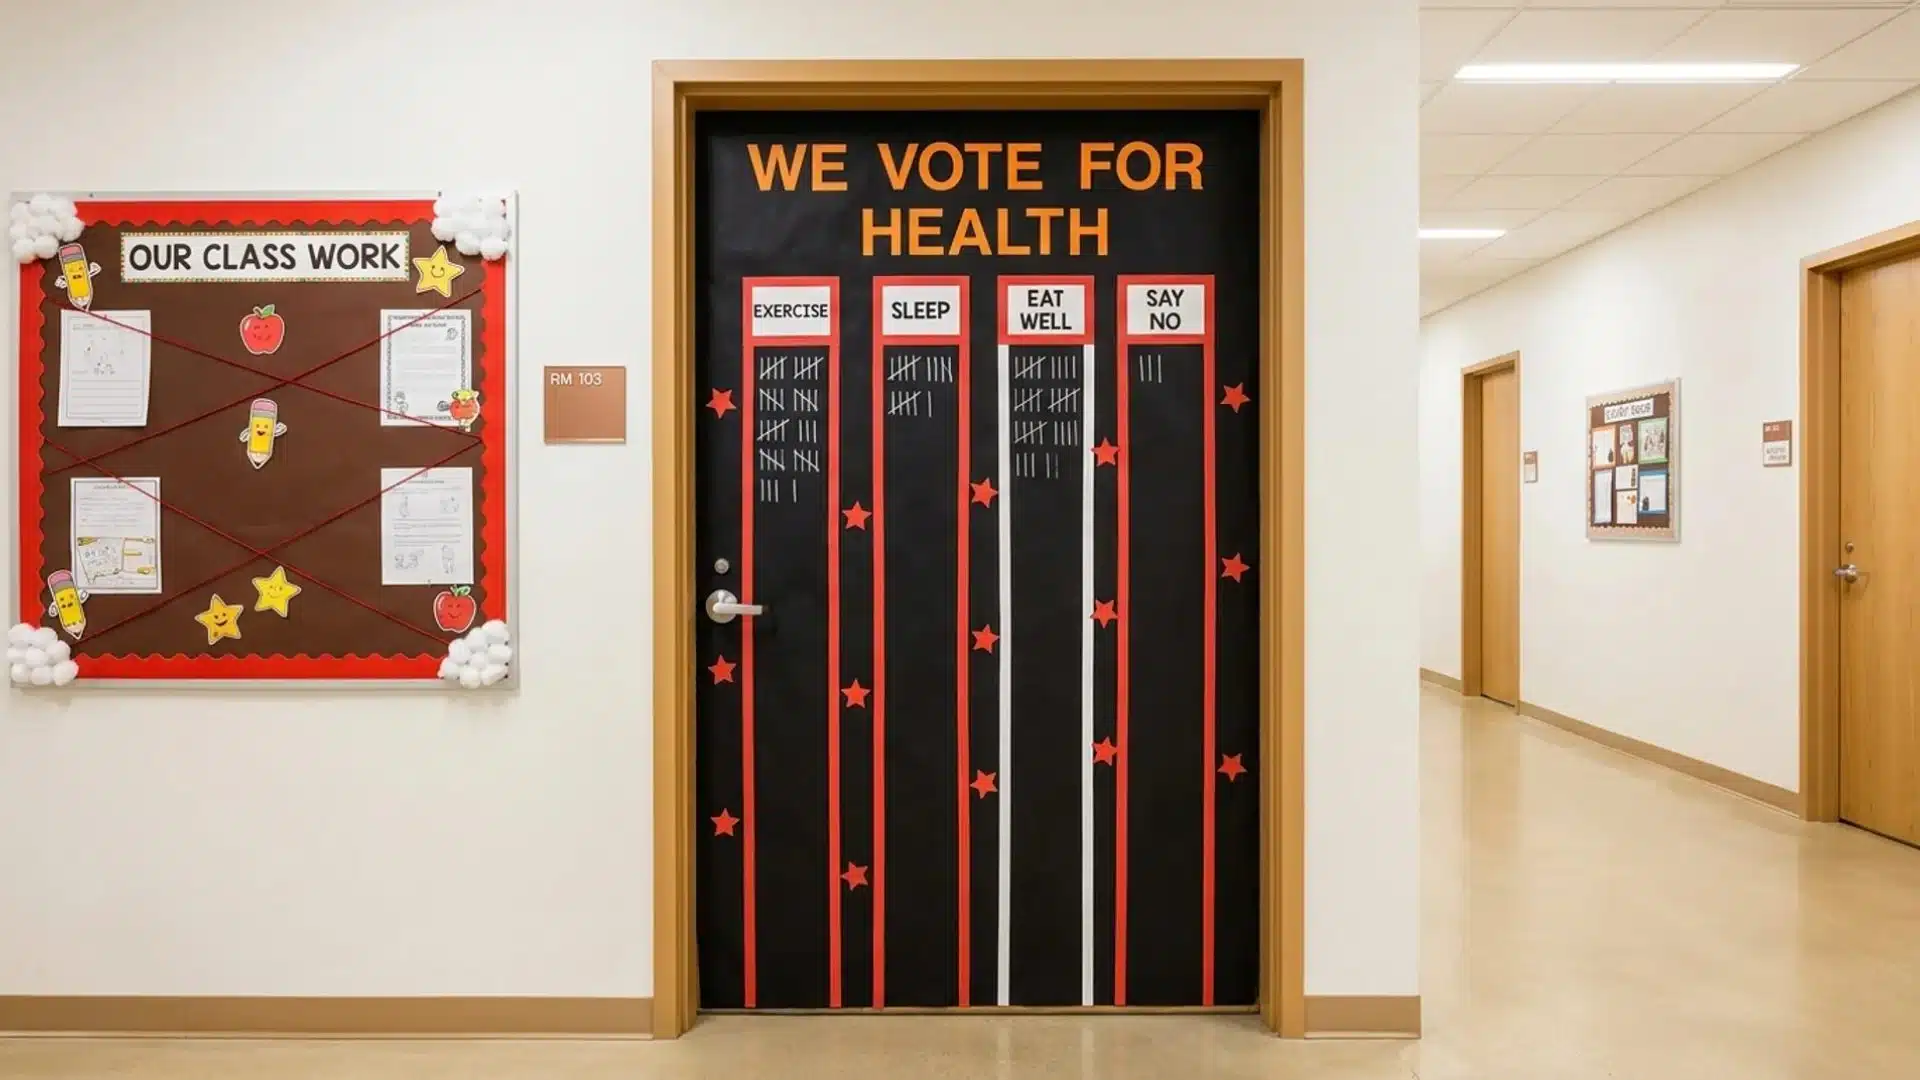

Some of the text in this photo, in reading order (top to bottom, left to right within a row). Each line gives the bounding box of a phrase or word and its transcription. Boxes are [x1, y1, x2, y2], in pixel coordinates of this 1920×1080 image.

[747, 141, 1205, 192] WE VOTE FOR
[862, 207, 1109, 256] HEALTH
[129, 243, 401, 271] OUR CLASS WORK
[1027, 289, 1064, 308] EAT
[1146, 289, 1185, 308] SAY
[753, 303, 829, 318] EXERCISE
[891, 301, 951, 320] SLEEP
[1020, 312, 1073, 331] WELL
[1150, 312, 1182, 331] NO
[550, 372, 602, 386] RM 103
